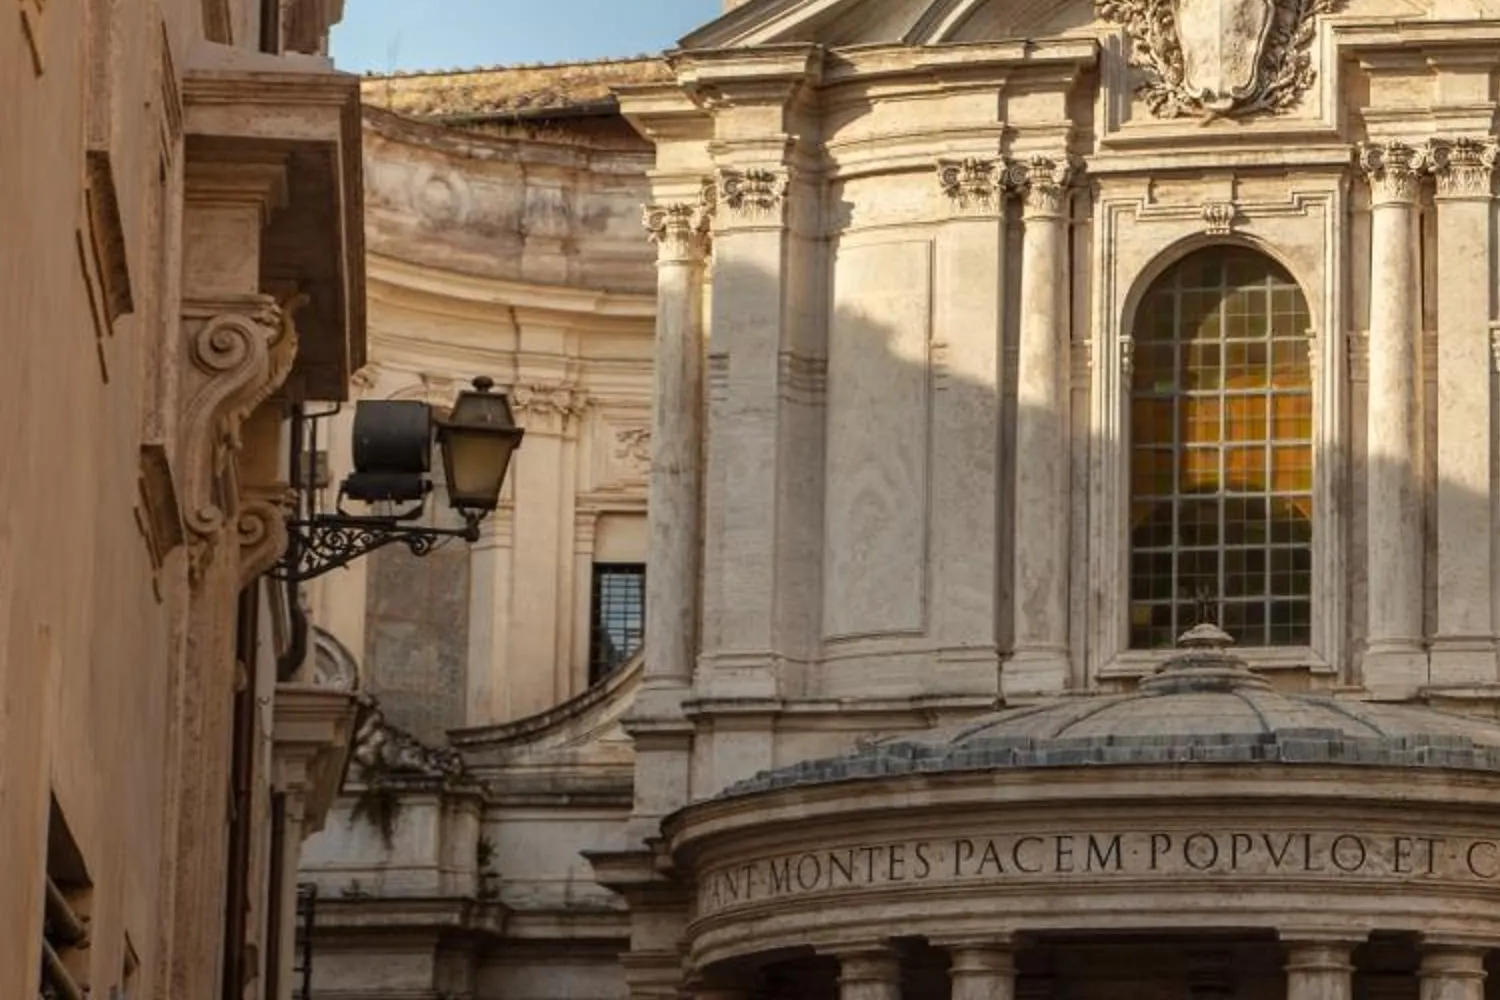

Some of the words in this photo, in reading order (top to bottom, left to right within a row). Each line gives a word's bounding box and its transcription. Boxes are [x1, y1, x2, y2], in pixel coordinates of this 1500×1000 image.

[703, 863, 759, 908] ANT
[767, 841, 931, 896] MONTES
[952, 833, 1123, 876] PACEM
[1149, 831, 1367, 873] POPVLO
[1393, 836, 1446, 875] ET
